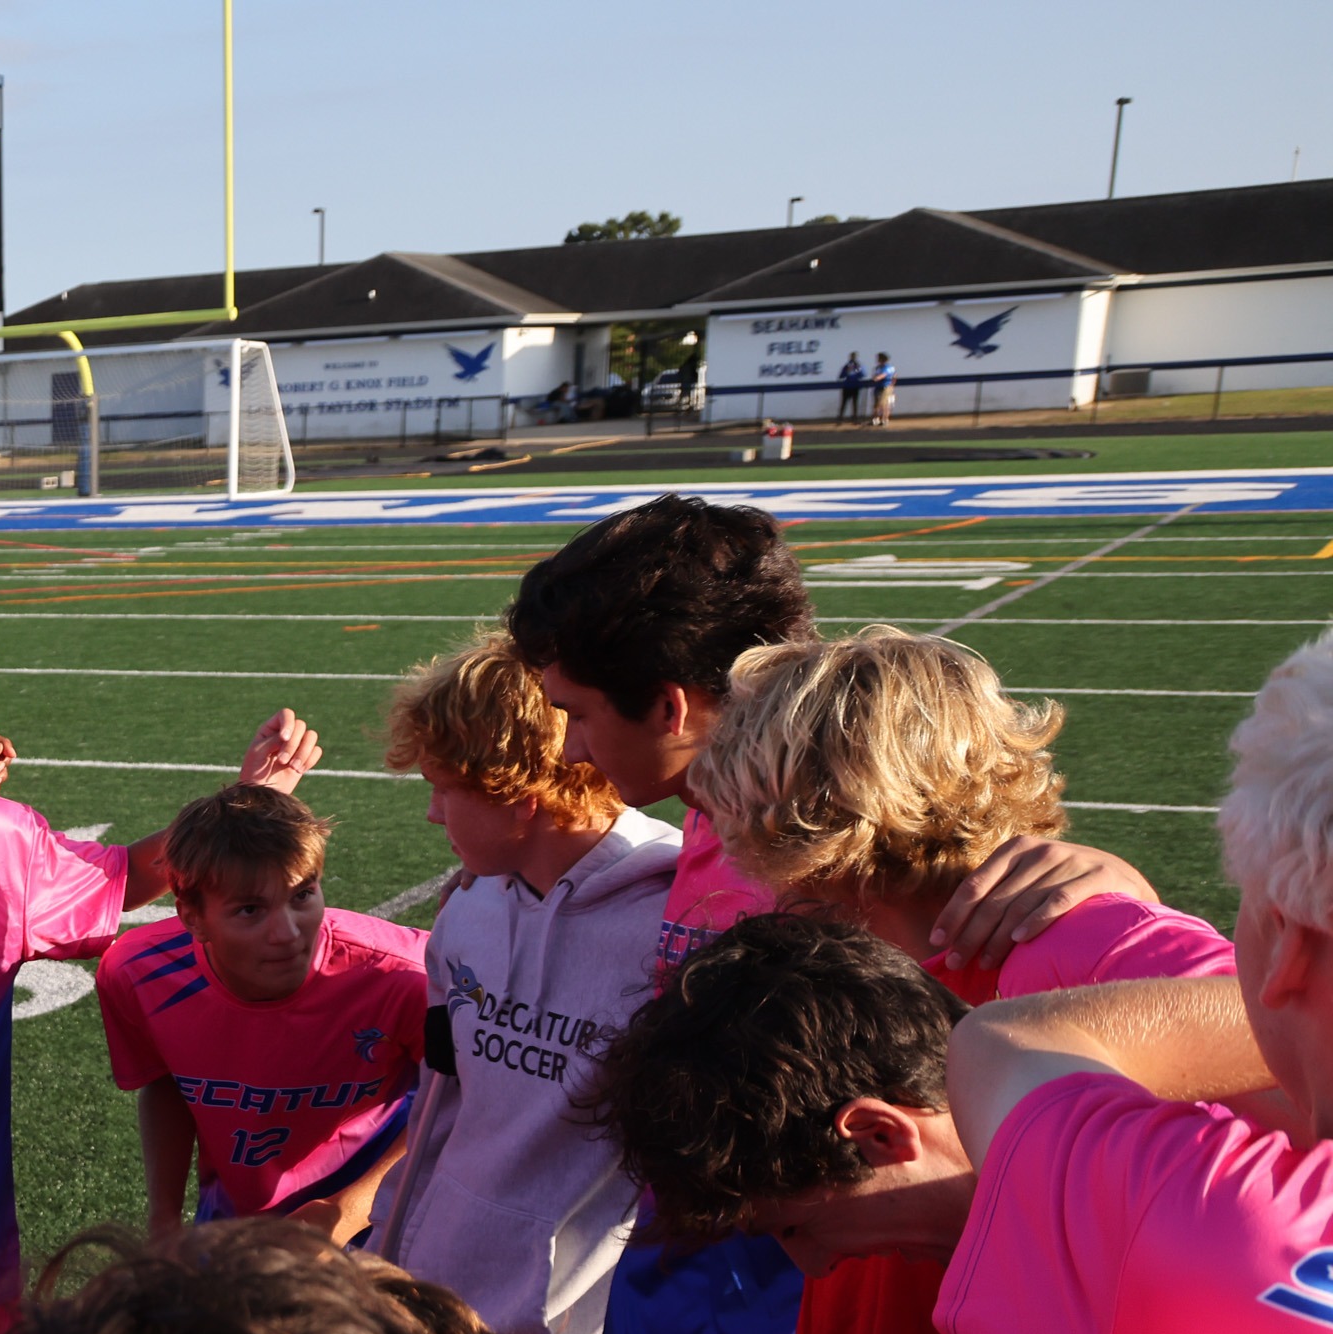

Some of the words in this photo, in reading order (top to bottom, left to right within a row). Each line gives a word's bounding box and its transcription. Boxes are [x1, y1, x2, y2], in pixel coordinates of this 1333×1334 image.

[751, 315, 841, 335] SEAHAWK
[767, 339, 821, 356] FIELD
[758, 360, 824, 379] HOUSE
[344, 378, 383, 391] KNOX
[386, 376, 429, 388] FIELD
[318, 400, 379, 414] TAYLOR
[478, 992, 598, 1050] DECATUR
[472, 1028, 568, 1084] SOCCER
[231, 1126, 293, 1168] 12
